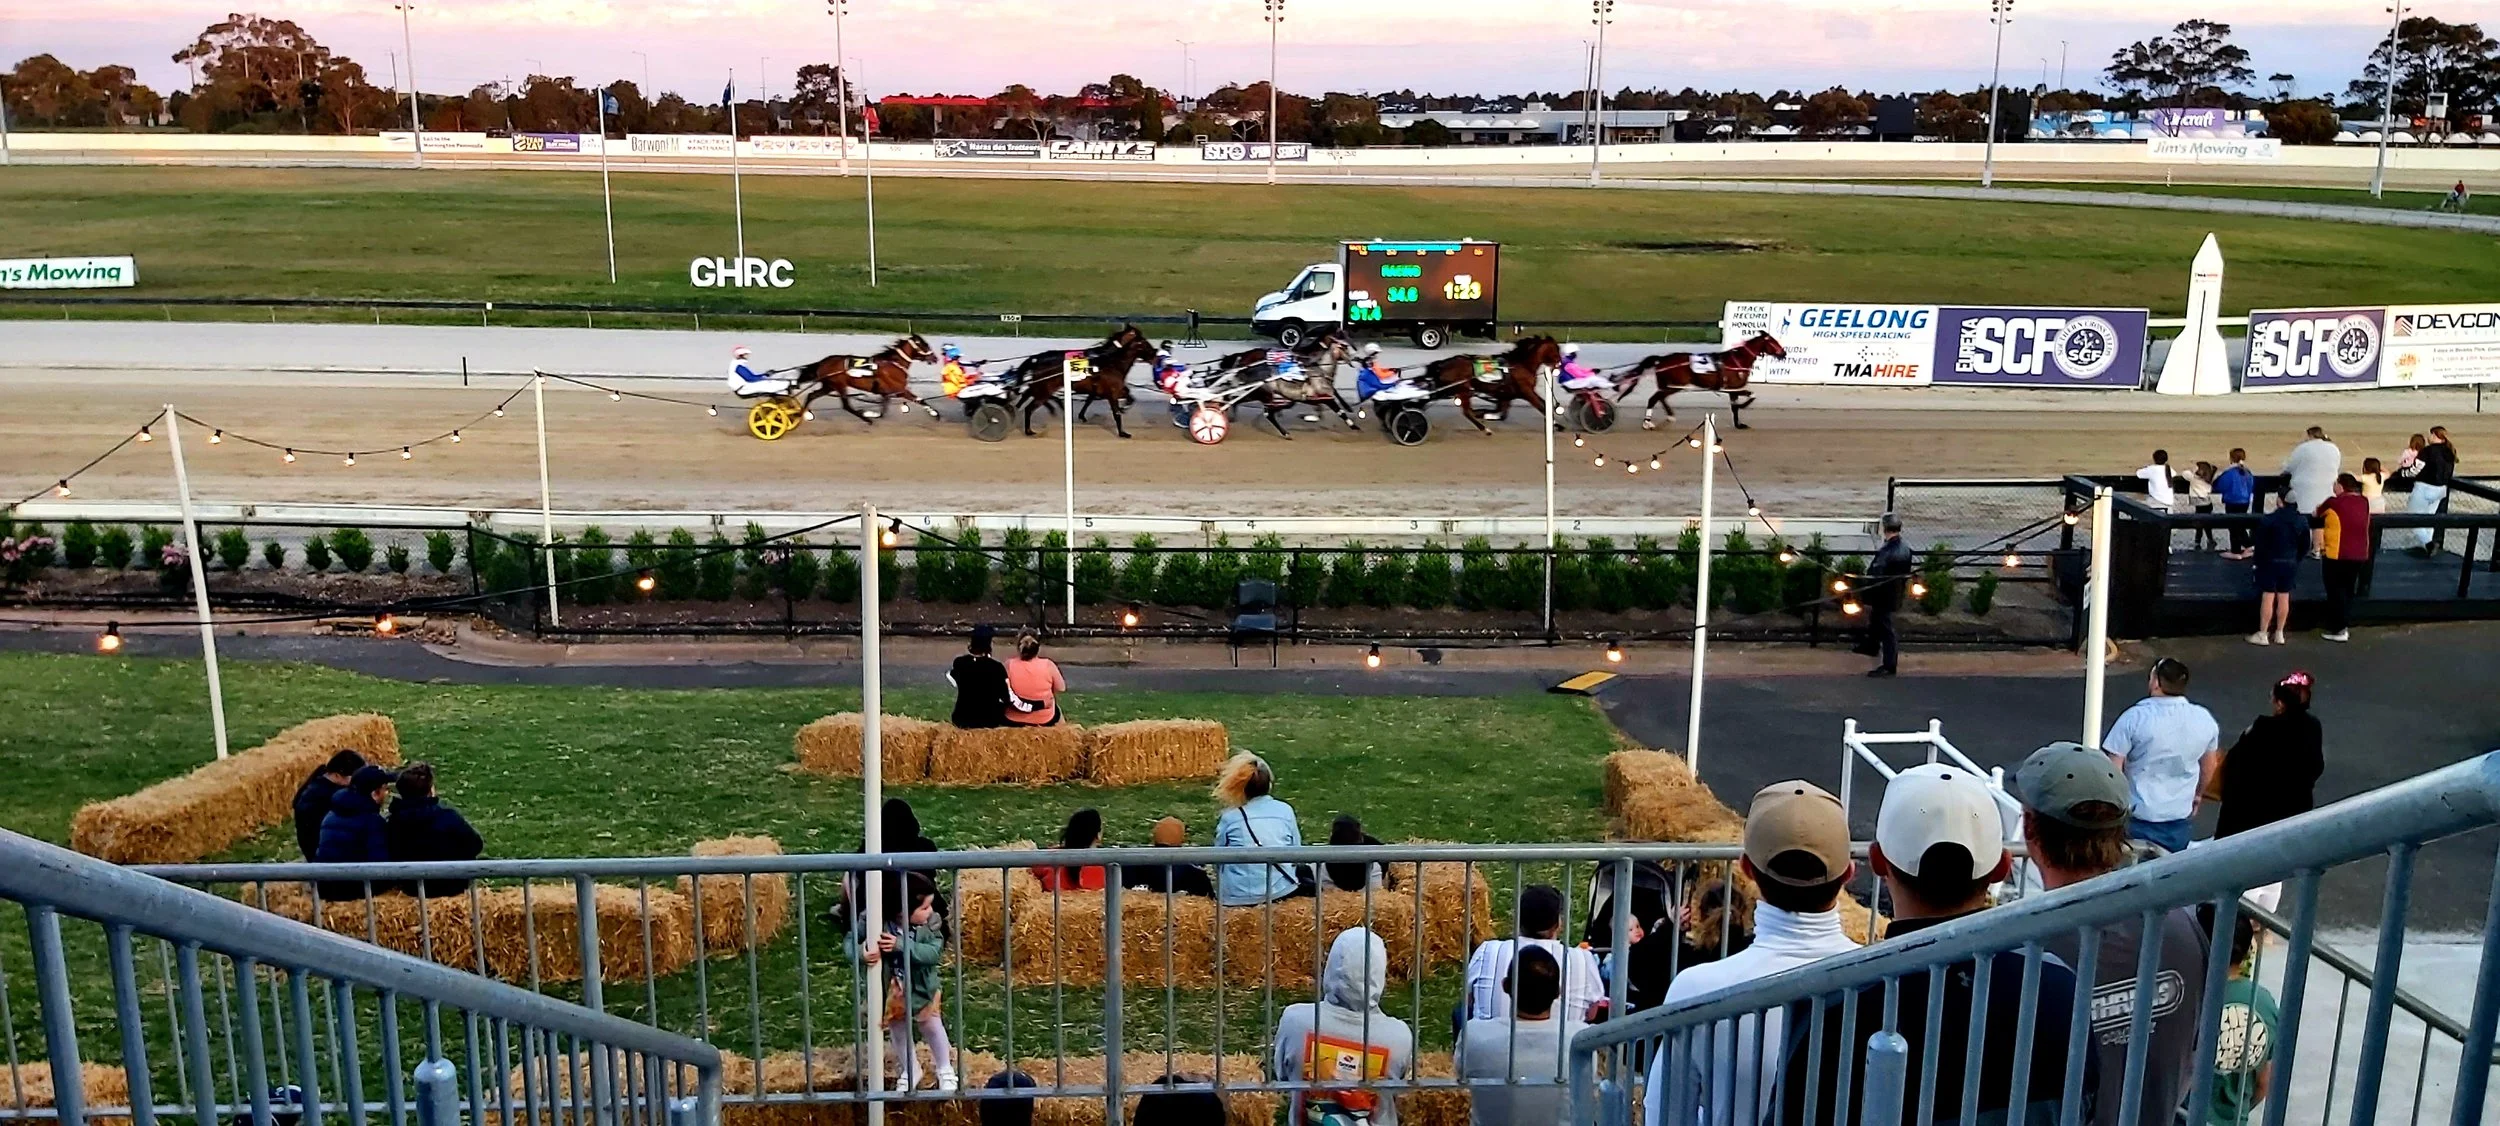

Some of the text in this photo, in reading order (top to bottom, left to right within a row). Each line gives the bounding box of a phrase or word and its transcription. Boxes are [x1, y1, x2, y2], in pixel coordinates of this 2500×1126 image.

[2154, 141, 2248, 157] Jim's Mowing
[27, 261, 121, 282] Mowing
[690, 257, 794, 287] GHRC
[1800, 308, 1929, 329] GEELONG
[1839, 331, 1871, 339] SPEED
[1872, 331, 1911, 339] RACING
[1955, 318, 1979, 372] EUREKA
[1973, 316, 2066, 375] SCF
[2262, 319, 2339, 377] SCF
[924, 515, 930, 525] 6
[1085, 517, 1093, 527] 5
[1247, 520, 1256, 529] 4
[1410, 520, 1418, 530] 3
[1573, 520, 1580, 530] 2
